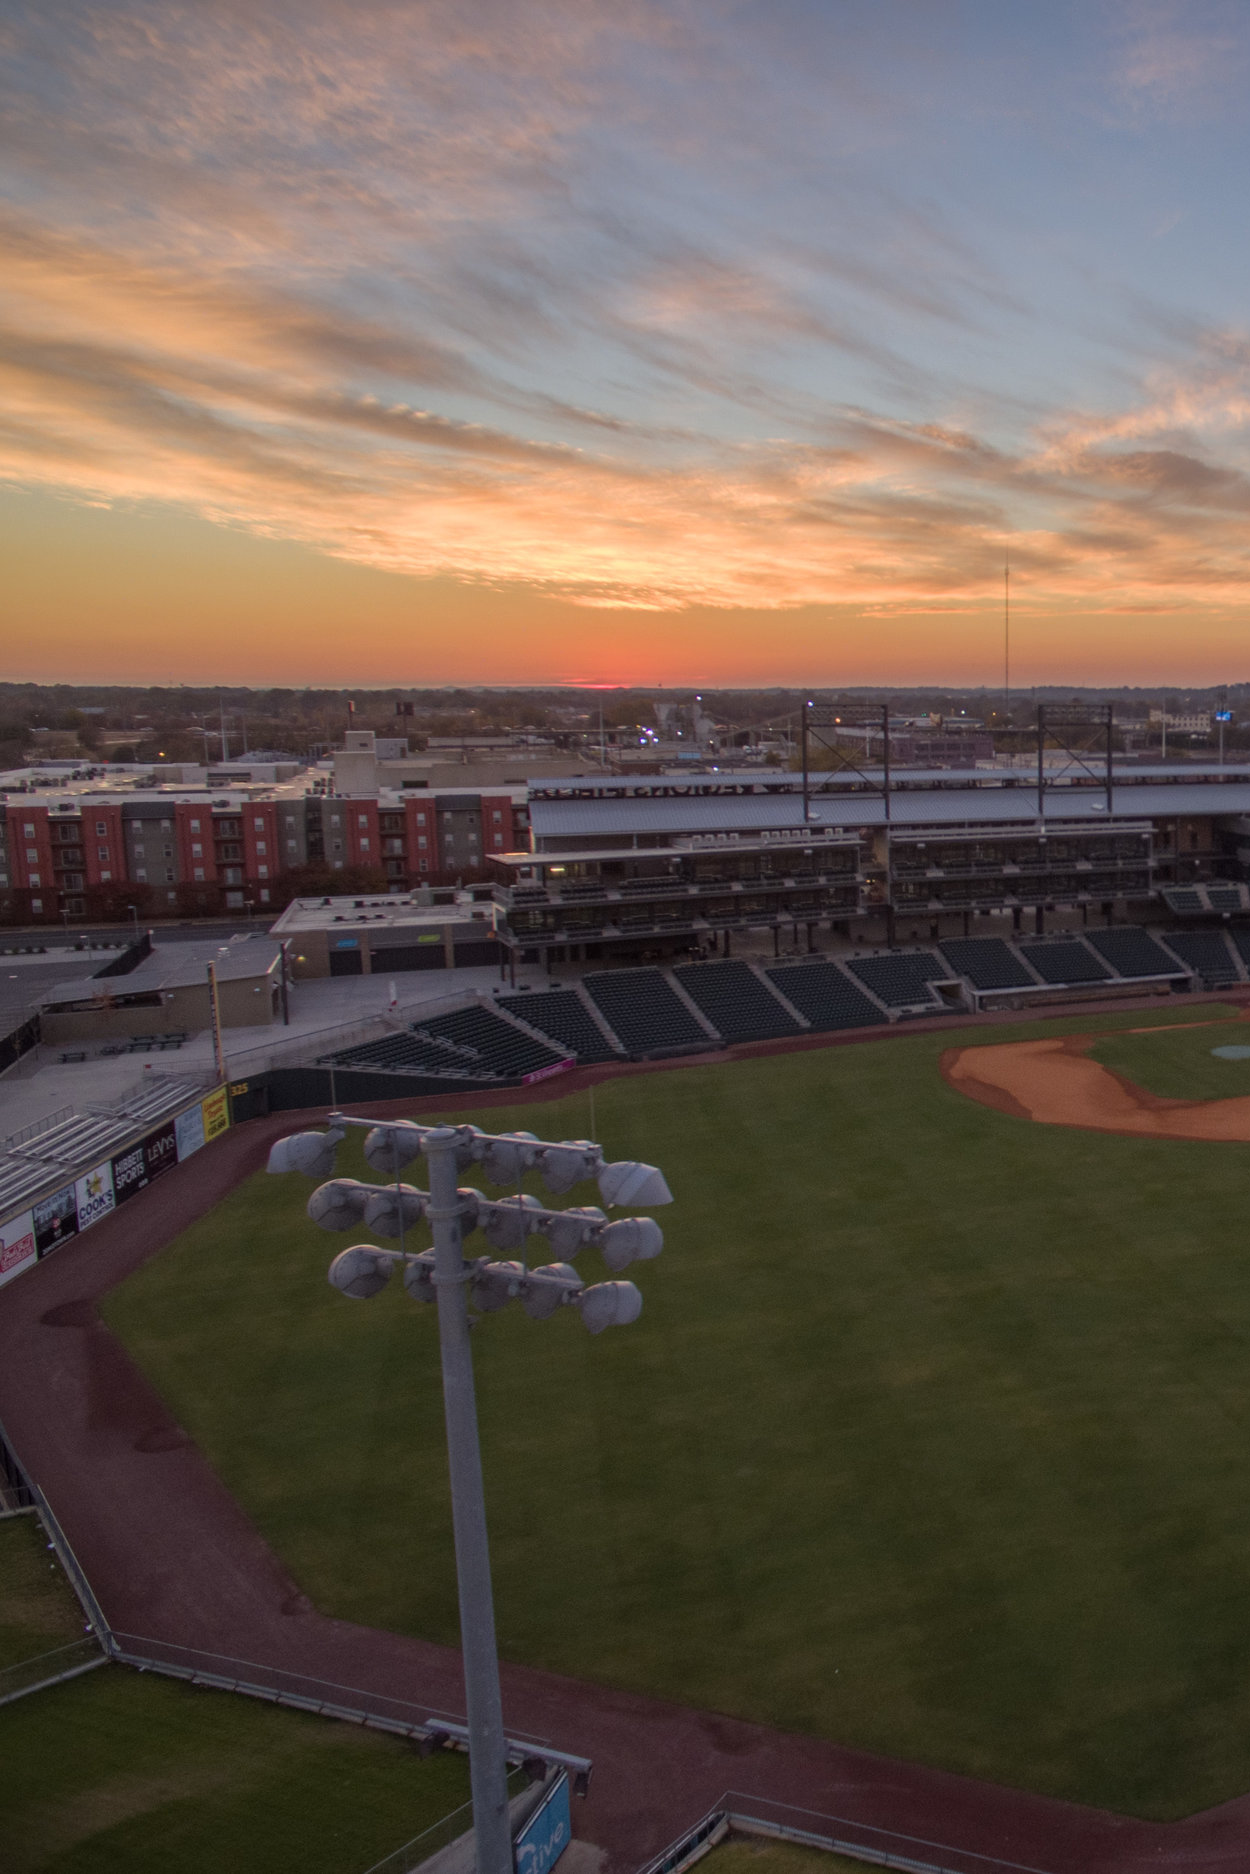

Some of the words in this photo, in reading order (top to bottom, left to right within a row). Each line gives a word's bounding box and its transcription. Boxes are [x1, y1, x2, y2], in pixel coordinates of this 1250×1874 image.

[114, 1147, 143, 1176] HIBBETT
[116, 1162, 145, 1189] SPORTS
[79, 1189, 113, 1220] COOK'S
